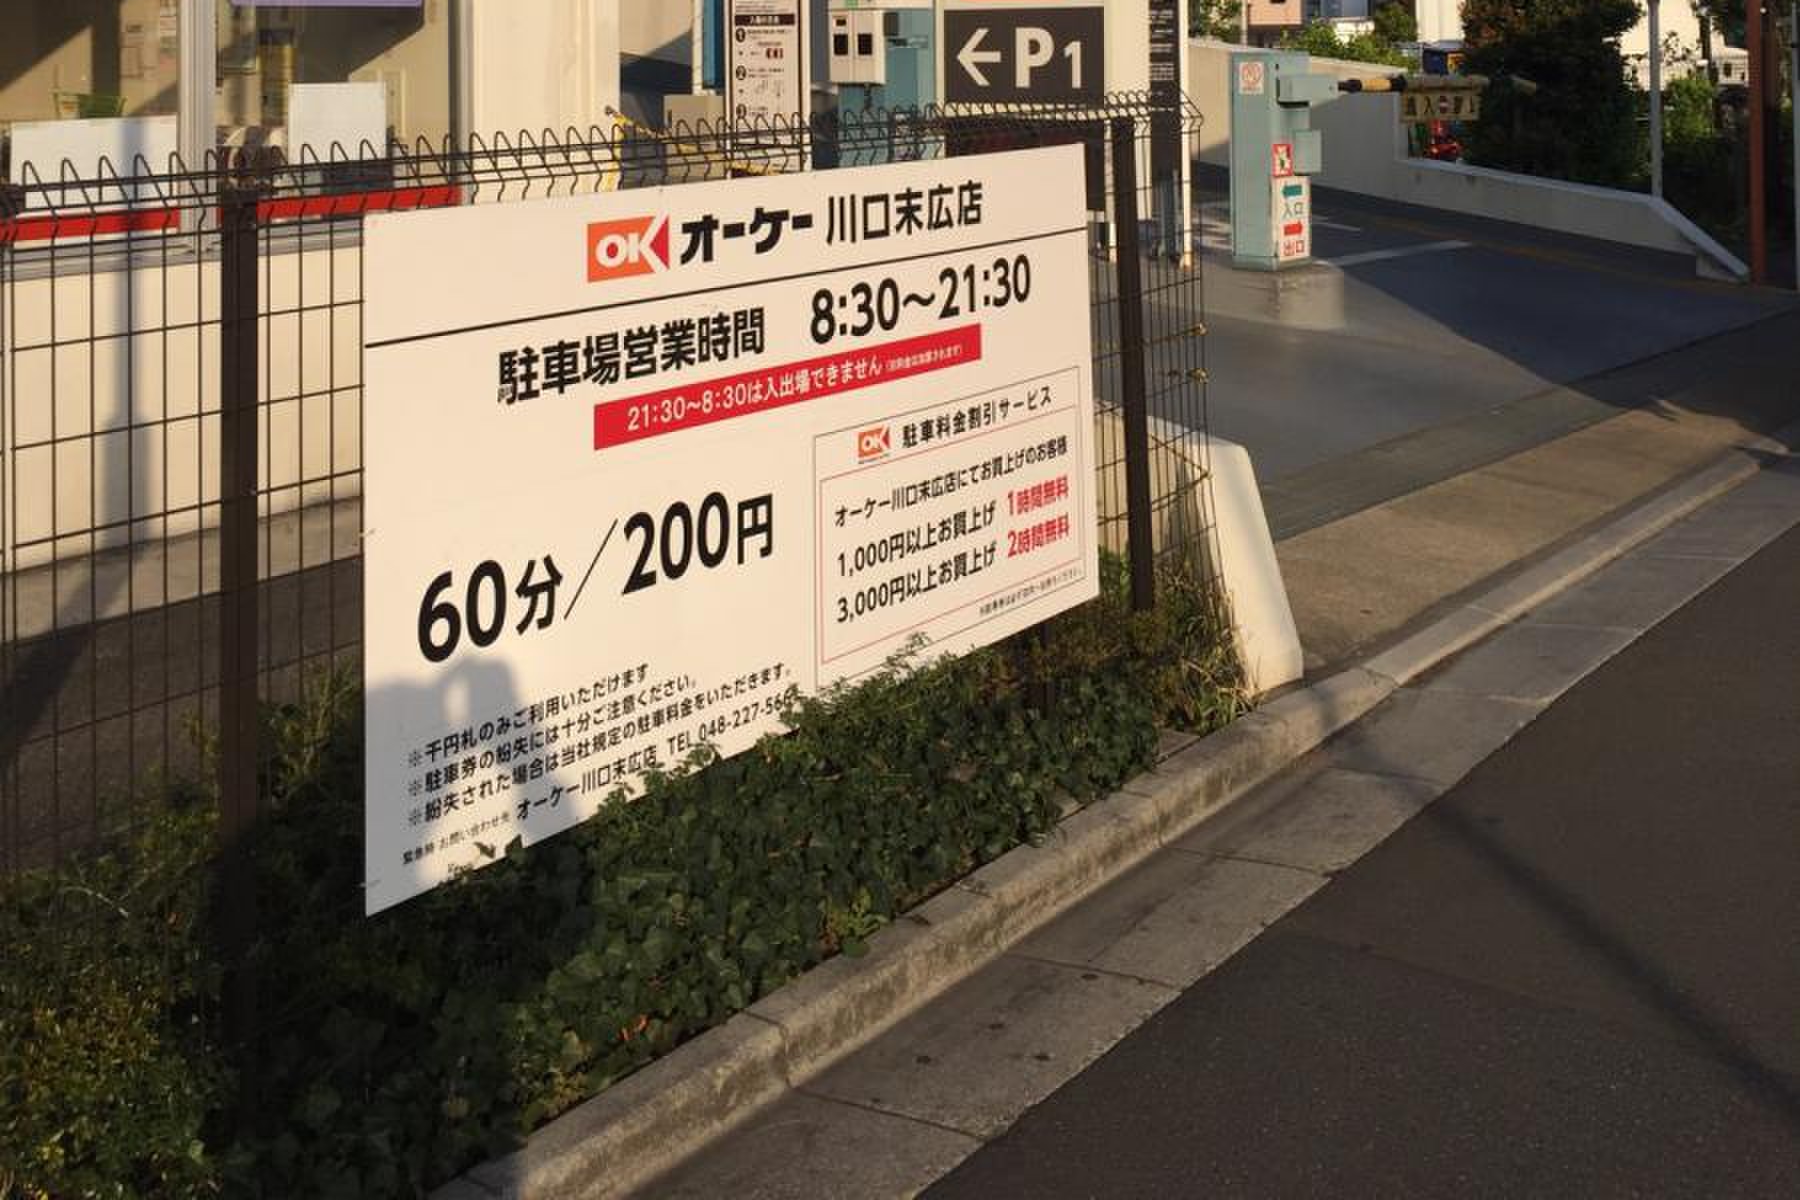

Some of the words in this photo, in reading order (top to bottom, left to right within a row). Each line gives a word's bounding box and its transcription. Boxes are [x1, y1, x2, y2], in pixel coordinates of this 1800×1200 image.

[1014, 26, 1082, 90] P1
[592, 211, 671, 277] OK
[679, 207, 813, 266] オーケー
[825, 179, 984, 246] 川口末広店
[1282, 201, 1304, 220] 入口
[1282, 239, 1305, 257] 出口
[496, 306, 765, 406] 駐車場営業時間
[809, 253, 1032, 345] 8:30～21:30
[859, 425, 891, 458] OK
[901, 385, 1052, 449] 駐車料金割引サービス
[834, 435, 1068, 528] オーケー川口末広店にてお買上げのお客様
[837, 499, 998, 578] 1,000円以上お買上げ
[1006, 475, 1070, 517] 1時間無料
[836, 540, 998, 624] 3,000円以上お買上げ
[1006, 514, 1071, 560] 2時間無料
[407, 662, 650, 769] ※千円札のみご利用いただけます
[516, 744, 659, 821] オーケー川口末広店
[666, 734, 693, 757] TEL
